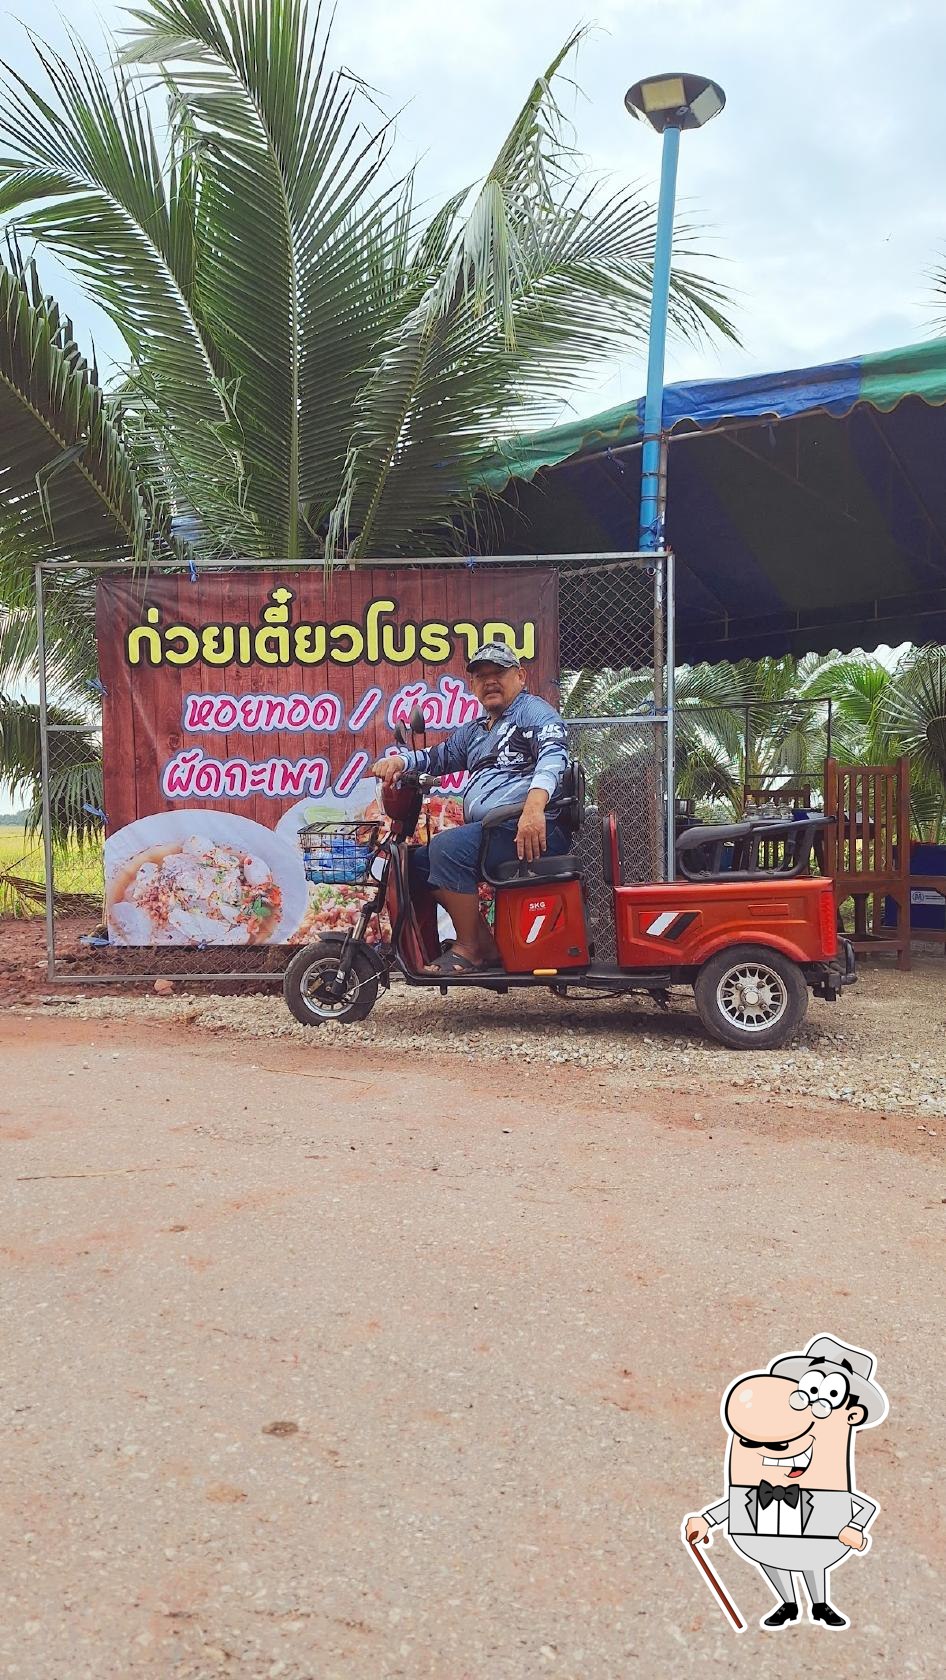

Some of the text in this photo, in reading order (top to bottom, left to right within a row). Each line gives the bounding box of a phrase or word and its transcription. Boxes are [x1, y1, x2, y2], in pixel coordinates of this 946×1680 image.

[187, 697, 338, 729] หอยทอด
[166, 752, 325, 793] ผัดกะเพา
[529, 901, 546, 909] SKG
